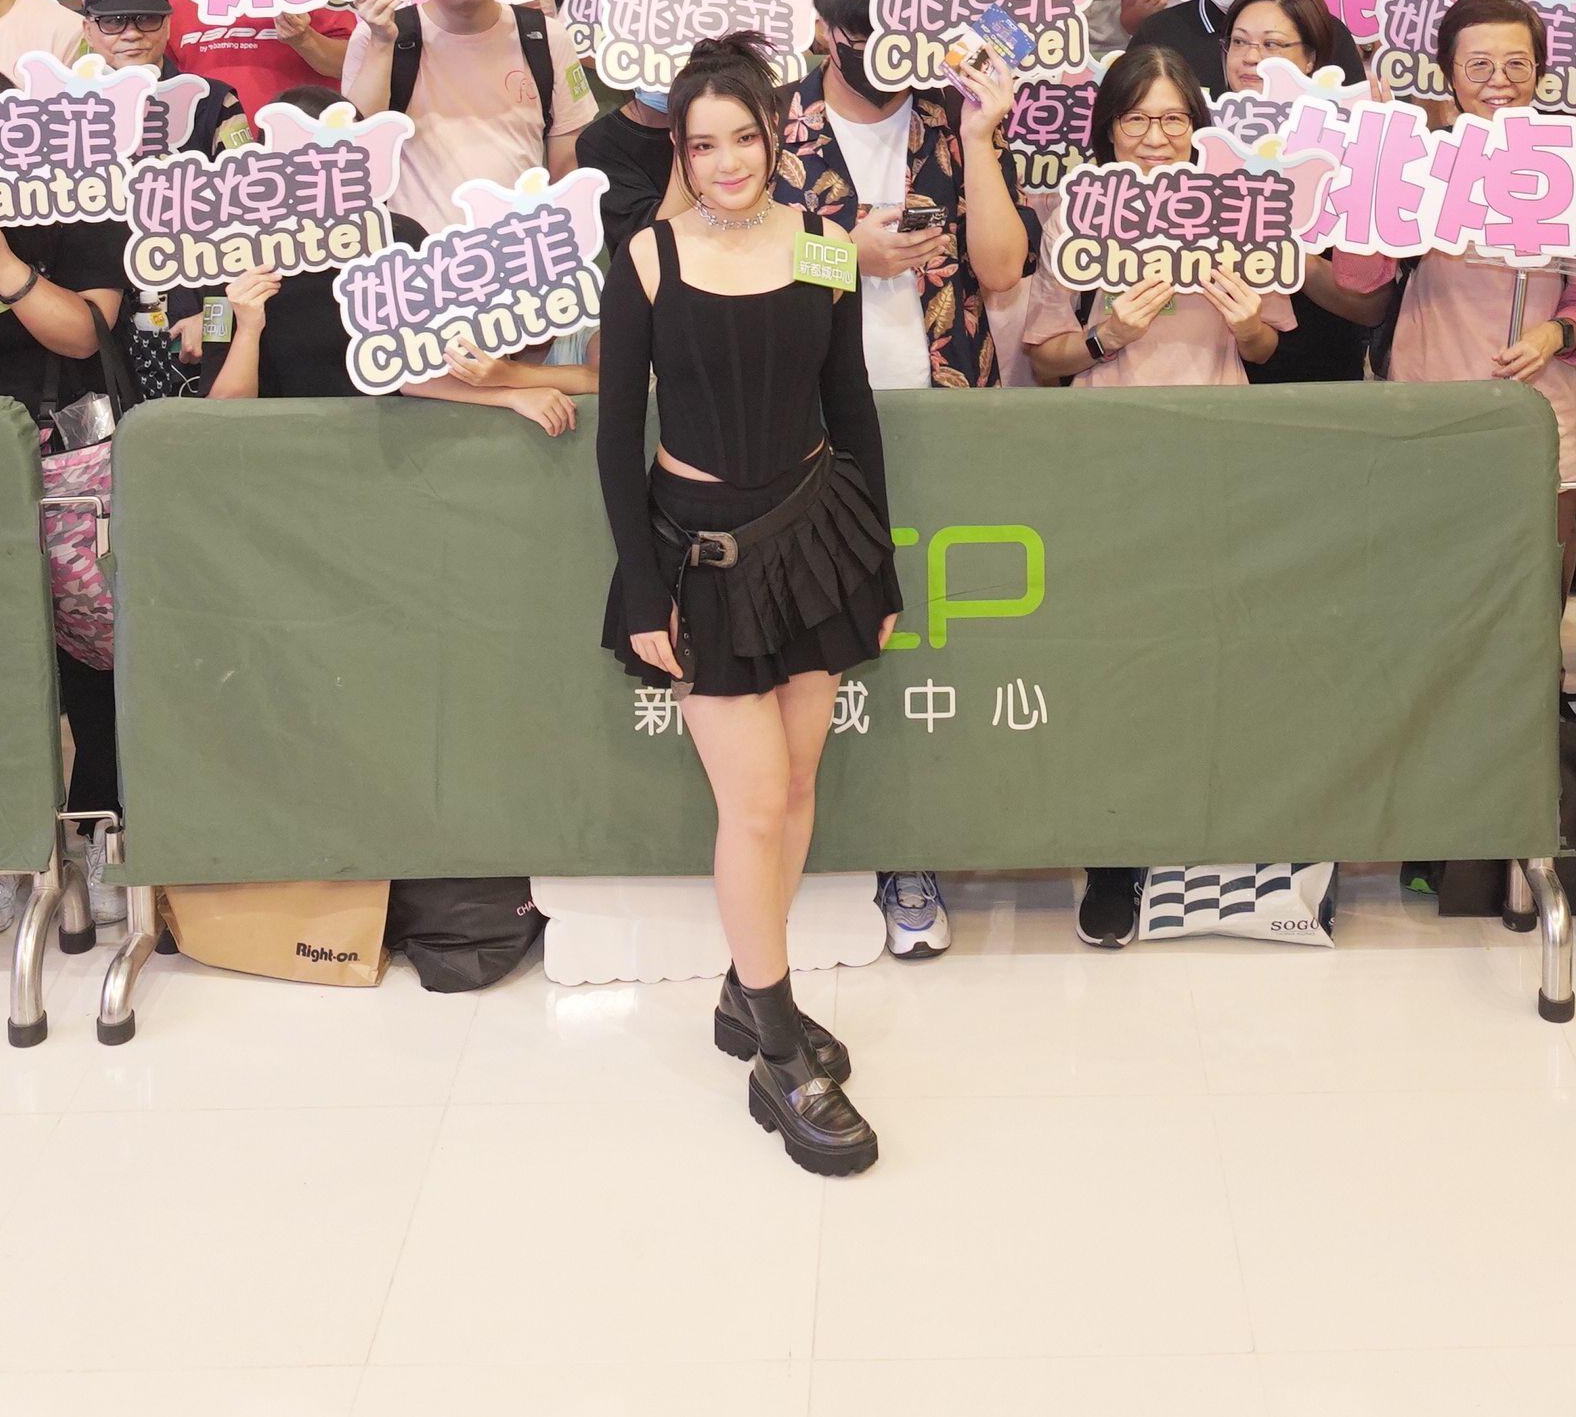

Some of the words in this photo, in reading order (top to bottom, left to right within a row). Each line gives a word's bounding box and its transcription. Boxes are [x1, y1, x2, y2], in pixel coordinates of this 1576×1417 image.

[134, 146, 369, 234] 姚焯菲
[1072, 174, 1290, 241] 姚焯菲
[135, 210, 381, 282] Chantel
[347, 210, 576, 332] 姚焯菲
[800, 261, 853, 285] 新都城中心
[1062, 239, 1294, 286] Chantel
[359, 270, 601, 383] Chantel
[634, 678, 1048, 736] 新城中心
[296, 942, 359, 963] Right-on
